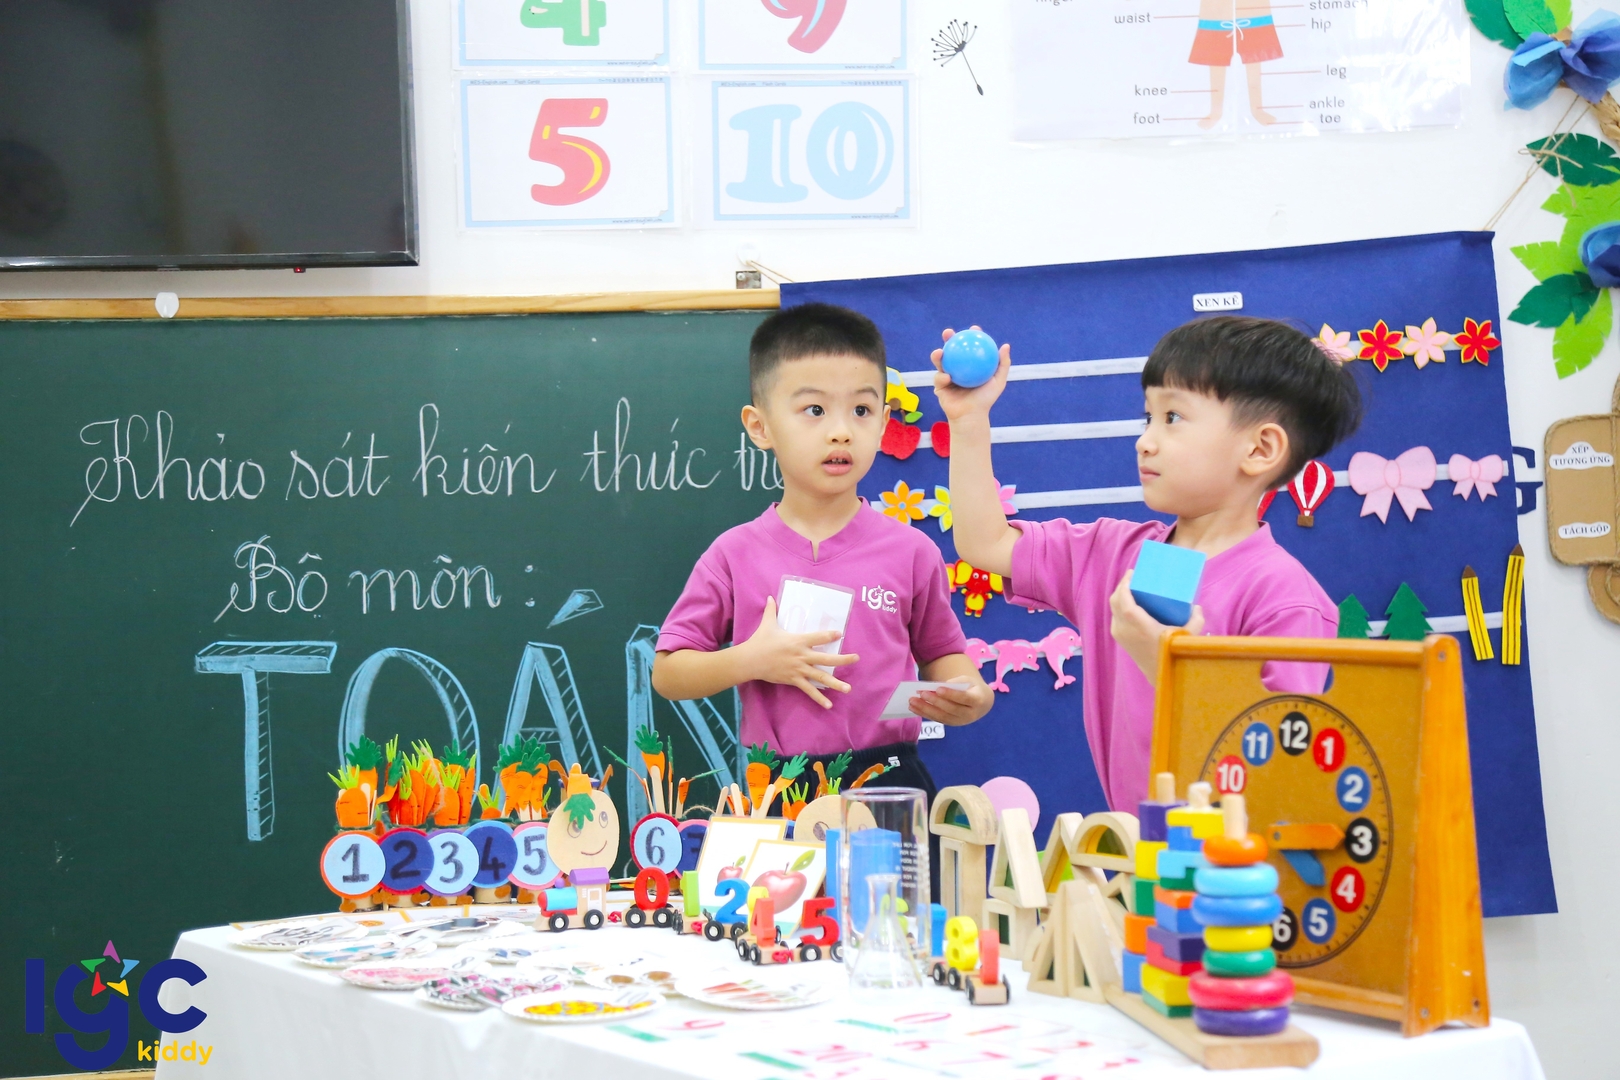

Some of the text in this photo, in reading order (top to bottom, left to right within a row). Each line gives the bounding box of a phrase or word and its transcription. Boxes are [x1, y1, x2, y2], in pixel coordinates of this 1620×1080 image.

[1114, 12, 1151, 24] waist
[1311, 17, 1332, 33] hip
[1326, 64, 1347, 79] leg
[1134, 84, 1168, 97] knee
[1309, 96, 1345, 110] ankle
[1133, 111, 1161, 126] foot
[1319, 112, 1342, 124] toe
[528, 97, 611, 206] 5
[725, 101, 895, 203] 10
[1196, 298, 1220, 308] XEN
[70, 410, 266, 527] Khảo
[285, 431, 390, 500] sát
[412, 402, 557, 497] kiến
[579, 396, 722, 492] thức
[1571, 443, 1589, 454] XẾP
[1562, 523, 1609, 536] TÁCH GỘP
[214, 534, 328, 623] Bộ
[1245, 731, 1268, 760] 11
[1279, 719, 1308, 749] 12
[1320, 737, 1334, 766] 1
[1217, 763, 1244, 792] 10
[1342, 774, 1363, 804] 2
[645, 826, 666, 867] 6
[1351, 825, 1372, 857] 3
[341, 834, 548, 884] 1 2 3 4 5
[1336, 873, 1356, 904] 4
[634, 867, 670, 910] 0
[714, 878, 751, 924] 2
[800, 897, 840, 947] 5
[1309, 906, 1328, 937] 5
[1273, 908, 1292, 942] 6
[945, 915, 979, 972] 8
